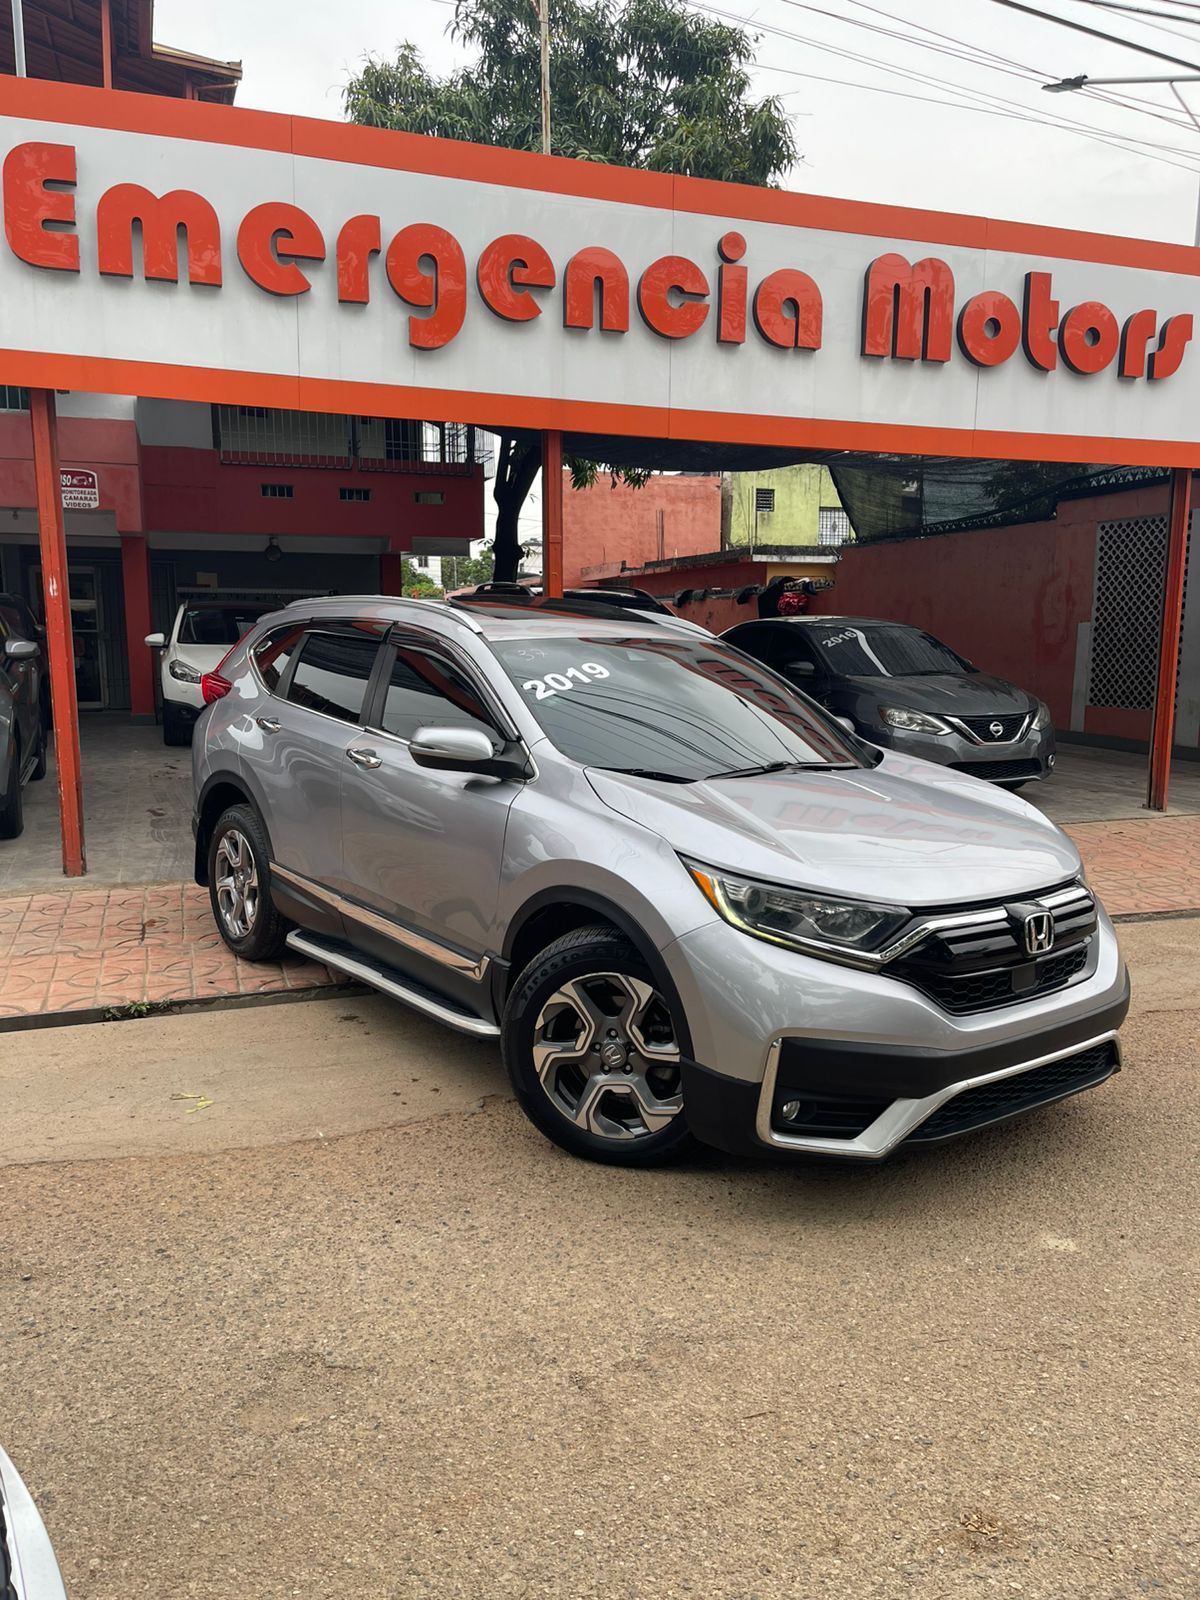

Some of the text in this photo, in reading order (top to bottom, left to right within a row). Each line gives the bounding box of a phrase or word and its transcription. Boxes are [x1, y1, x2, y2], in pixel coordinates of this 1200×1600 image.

[3, 141, 1194, 380] Emergencia Motors
[822, 631, 857, 647] 2016
[522, 662, 610, 700] 2019
